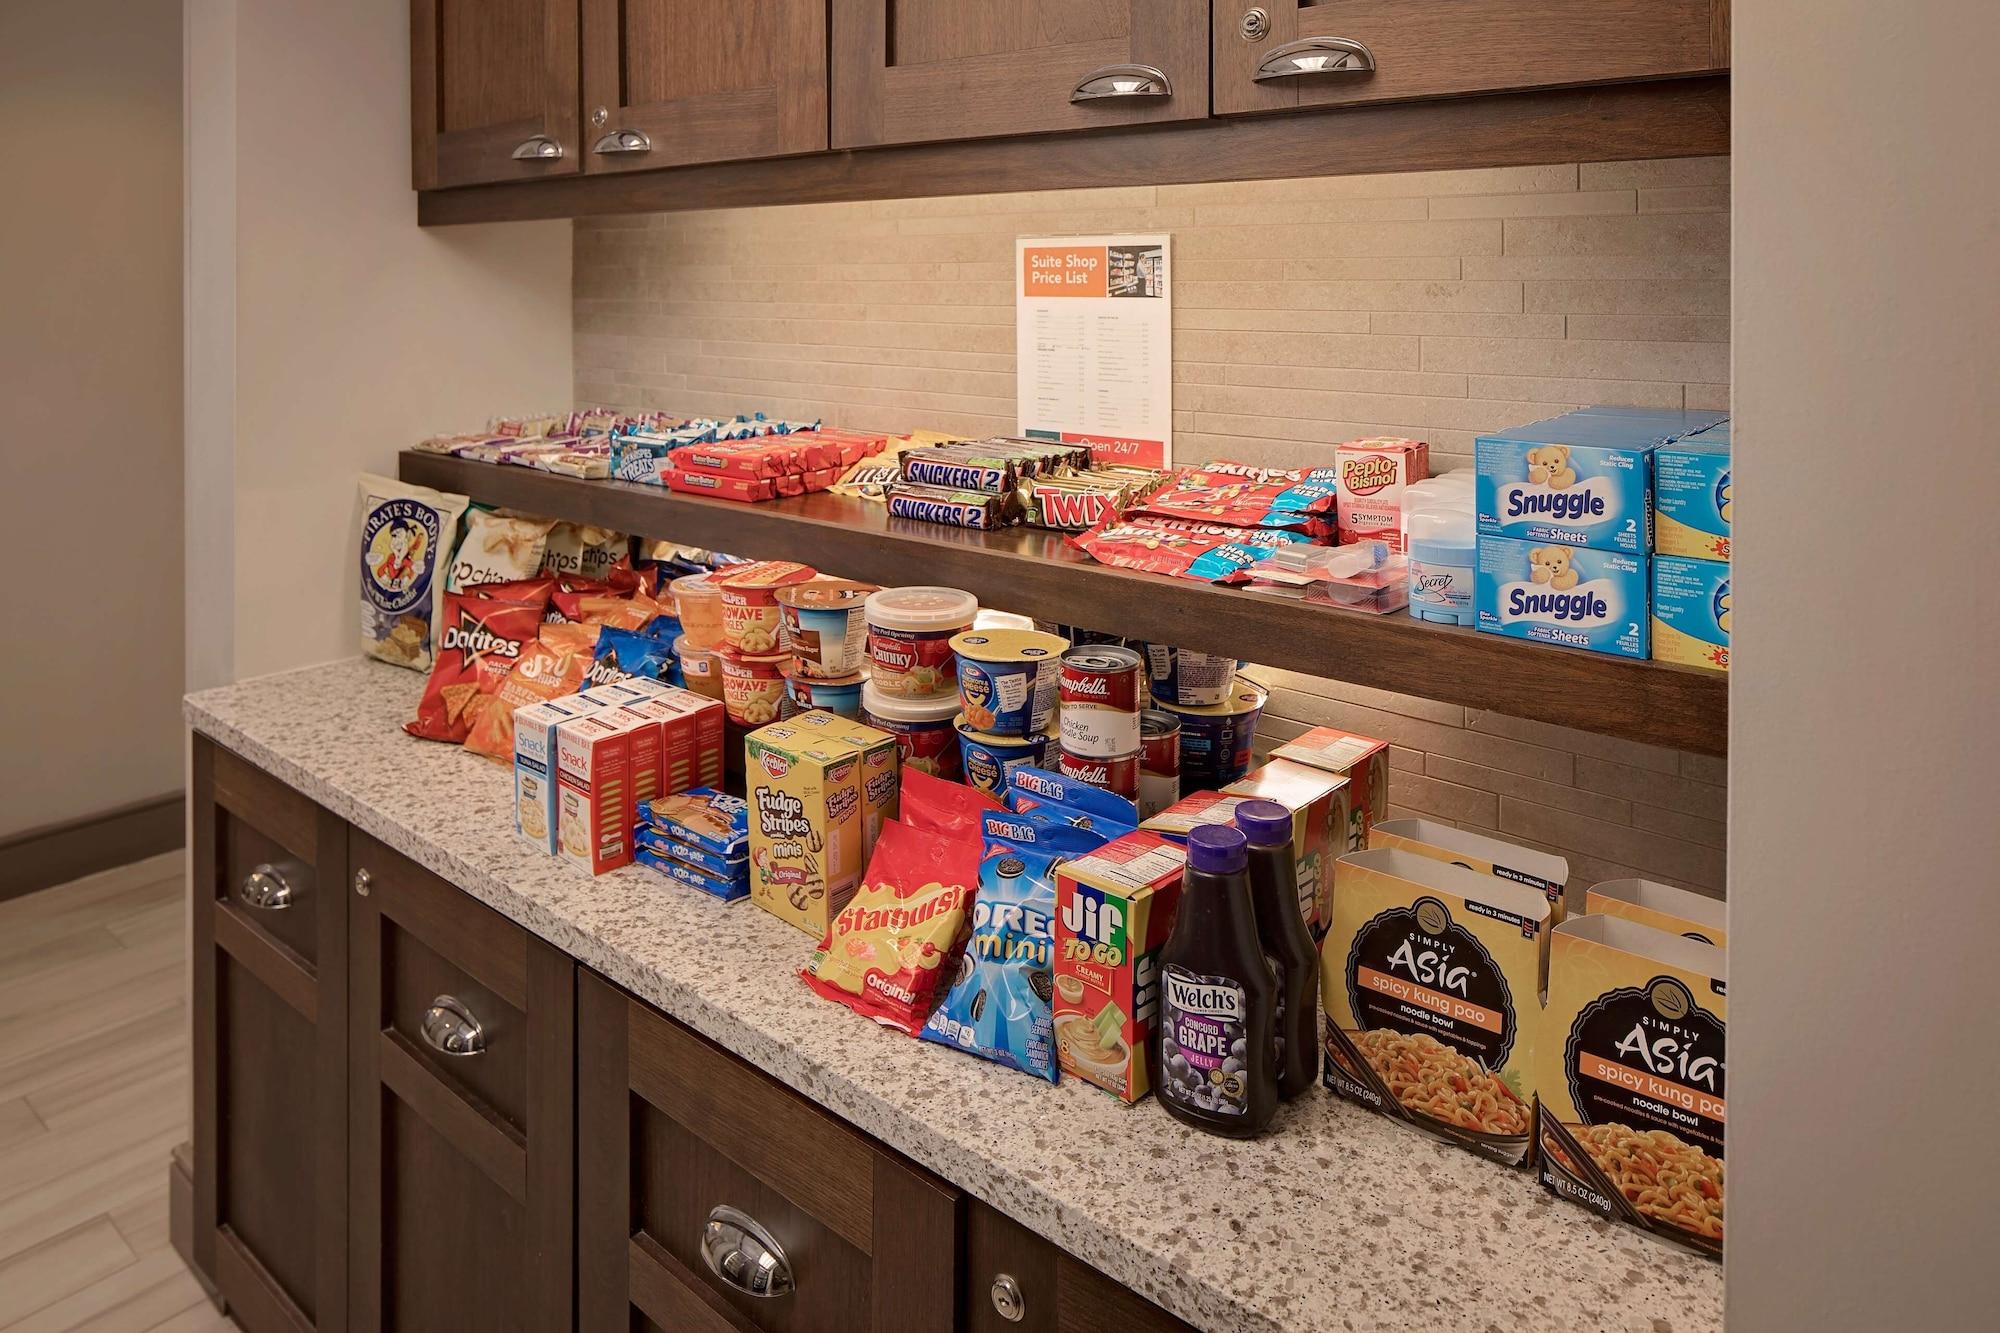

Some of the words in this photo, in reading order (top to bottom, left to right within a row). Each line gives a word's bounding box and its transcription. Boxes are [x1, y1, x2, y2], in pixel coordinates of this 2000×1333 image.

[1032, 255, 1061, 268] Suite
[1066, 254, 1097, 271] Shop
[1032, 271, 1061, 284] Price
[1066, 271, 1087, 284] List
[1080, 438, 1111, 454] Open
[1113, 441, 1139, 454] 24/7
[1343, 458, 1397, 479] Pepto-
[1609, 455, 1633, 463] Reduces
[909, 462, 979, 490] SNICKERS
[985, 471, 1000, 488] 2
[1350, 469, 1396, 489] Bismol
[891, 498, 962, 526] SNICKERS
[967, 508, 981, 526] 2
[1035, 487, 1119, 526] TWIX
[1508, 489, 1604, 519] Snuggle
[364, 503, 412, 545] PIRATE'S
[415, 507, 440, 553] BOOTY
[1351, 513, 1358, 523] 5
[1358, 513, 1393, 522] SYMPTOM
[1626, 519, 1636, 532] 2
[1550, 529, 1587, 543] Sheets
[1614, 536, 1636, 544] FEUILLES
[1603, 562, 1620, 570] Static
[1621, 564, 1637, 573] Cling
[1612, 558, 1637, 566] Reduces
[1417, 574, 1453, 592] Secret
[1509, 588, 1606, 620] Snuggle
[1551, 629, 1589, 645] Sheets
[1629, 622, 1639, 636] 2
[444, 626, 521, 657] Doritos
[1616, 640, 1639, 648] FEUILLES
[873, 646, 912, 668] CHUNKY
[962, 680, 990, 694] Cheese
[1063, 716, 1089, 732] Chicken
[518, 732, 546, 755] Snack
[1078, 731, 1100, 745] Soup
[561, 746, 588, 771] Snack
[761, 752, 788, 775] Keebler
[968, 761, 997, 778] Cheese
[865, 770, 893, 791] Fudge
[1016, 772, 1039, 791] BIG
[1039, 779, 1063, 800] BAG
[756, 787, 801, 818] Fudge
[826, 785, 854, 808] Fudge
[829, 791, 858, 818] Stripes
[761, 810, 809, 838] Stripes
[986, 819, 1010, 837] BIG
[1010, 824, 1035, 842] BAG
[773, 841, 803, 859] minis
[778, 871, 802, 880] Original
[1496, 868, 1512, 879] ready
[1523, 877, 1546, 889] minutes
[837, 886, 964, 937] Starburst
[975, 901, 1054, 938] ORE
[1062, 892, 1123, 946] Jif
[1469, 904, 1485, 914] ready
[1485, 908, 1491, 916] in
[1497, 912, 1521, 925] minutes
[1065, 938, 1091, 961] TO
[1093, 942, 1123, 968] GO
[1409, 932, 1456, 954] SIMPLY
[1075, 964, 1105, 983] CREAMY
[1386, 939, 1470, 999] Asia
[866, 973, 917, 1005] Original
[1171, 981, 1236, 1011] Welch's
[1372, 975, 1410, 997] spicy
[1413, 991, 1450, 1014] kung
[1454, 1004, 1485, 1023] pao
[1184, 1016, 1219, 1036] CONCORD
[1400, 1004, 1430, 1021] noodle
[1432, 1013, 1454, 1030] bowl
[1642, 1015, 1699, 1042] SIMPLY
[1179, 1025, 1227, 1057] GRAPE
[1391, 1010, 1410, 1023] noodles
[1415, 1021, 1428, 1030] sauce
[1428, 1024, 1438, 1032] with
[1438, 1027, 1462, 1042] vegetables
[1467, 1037, 1487, 1050] toppings
[1061, 1039, 1069, 1054] 8
[1614, 1022, 1718, 1092] Asia
[1191, 1053, 1213, 1068] JELLY
[1326, 1074, 1336, 1084] NET
[1336, 1079, 1345, 1089] WT
[1345, 1081, 1354, 1093] 8.5
[1354, 1085, 1363, 1096] OZ
[1363, 1088, 1382, 1107] (240g)
[1597, 1063, 1643, 1090] spicy
[1648, 1078, 1694, 1109] kung
[1700, 1097, 1725, 1117] pa
[1623, 1104, 1646, 1118] noodles
[1651, 1114, 1668, 1124] sauce
[1668, 1119, 1679, 1129] with
[1679, 1123, 1710, 1141] vegetables
[1632, 1096, 1669, 1116] noodle
[1672, 1108, 1699, 1127] bowl
[1543, 1171, 1555, 1184] NET
[1556, 1177, 1566, 1190] WT
[1566, 1180, 1577, 1195] 8.5
[1578, 1186, 1588, 1200] OZ
[1588, 1190, 1612, 1212] (240g)
